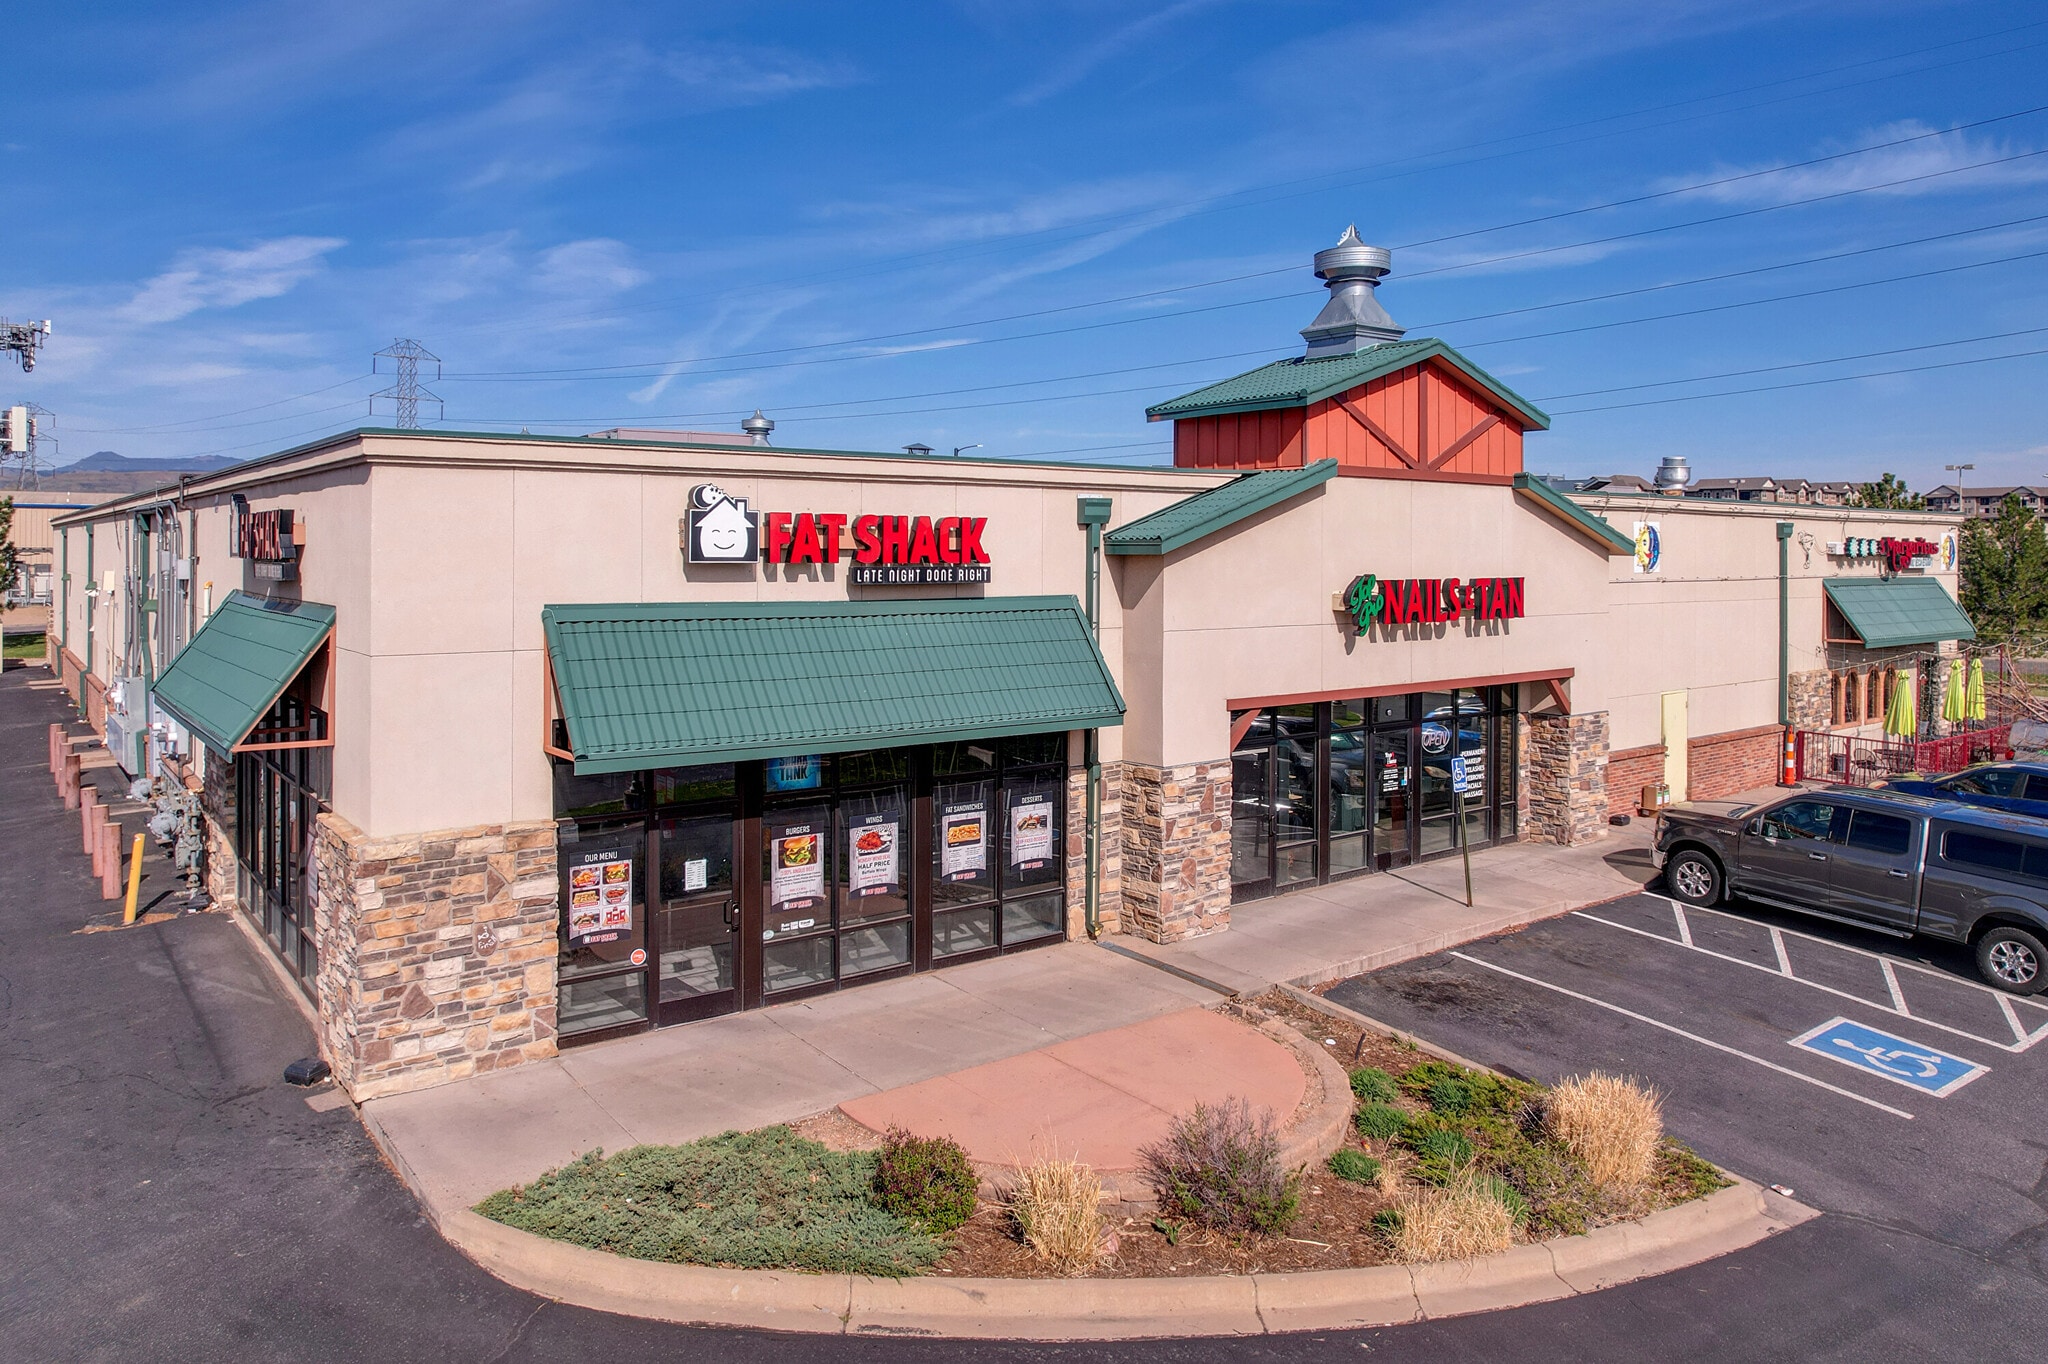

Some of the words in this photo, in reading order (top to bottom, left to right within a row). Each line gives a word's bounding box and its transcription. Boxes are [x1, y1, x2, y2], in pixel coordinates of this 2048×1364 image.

[768, 512, 847, 563] FAT
[855, 514, 991, 564] SHACK
[1887, 537, 1939, 572] Margaritas
[857, 569, 883, 582] LATE
[888, 567, 921, 582] NIGHT
[926, 568, 953, 582] DONE
[958, 567, 988, 581] RIGHT
[1384, 577, 1462, 624] NAILS
[1465, 585, 1475, 609] &
[1475, 577, 1525, 620] TAN
[1423, 731, 1447, 746] OPEN
[780, 766, 808, 781] TANK
[1021, 795, 1042, 804] DESSERTS
[954, 803, 983, 813] SANDWICHES
[865, 815, 883, 824] WINGS
[785, 825, 810, 836] BURGERS
[584, 853, 599, 862] OUR
[600, 851, 618, 861] MENU
[858, 862, 873, 870] HALF
